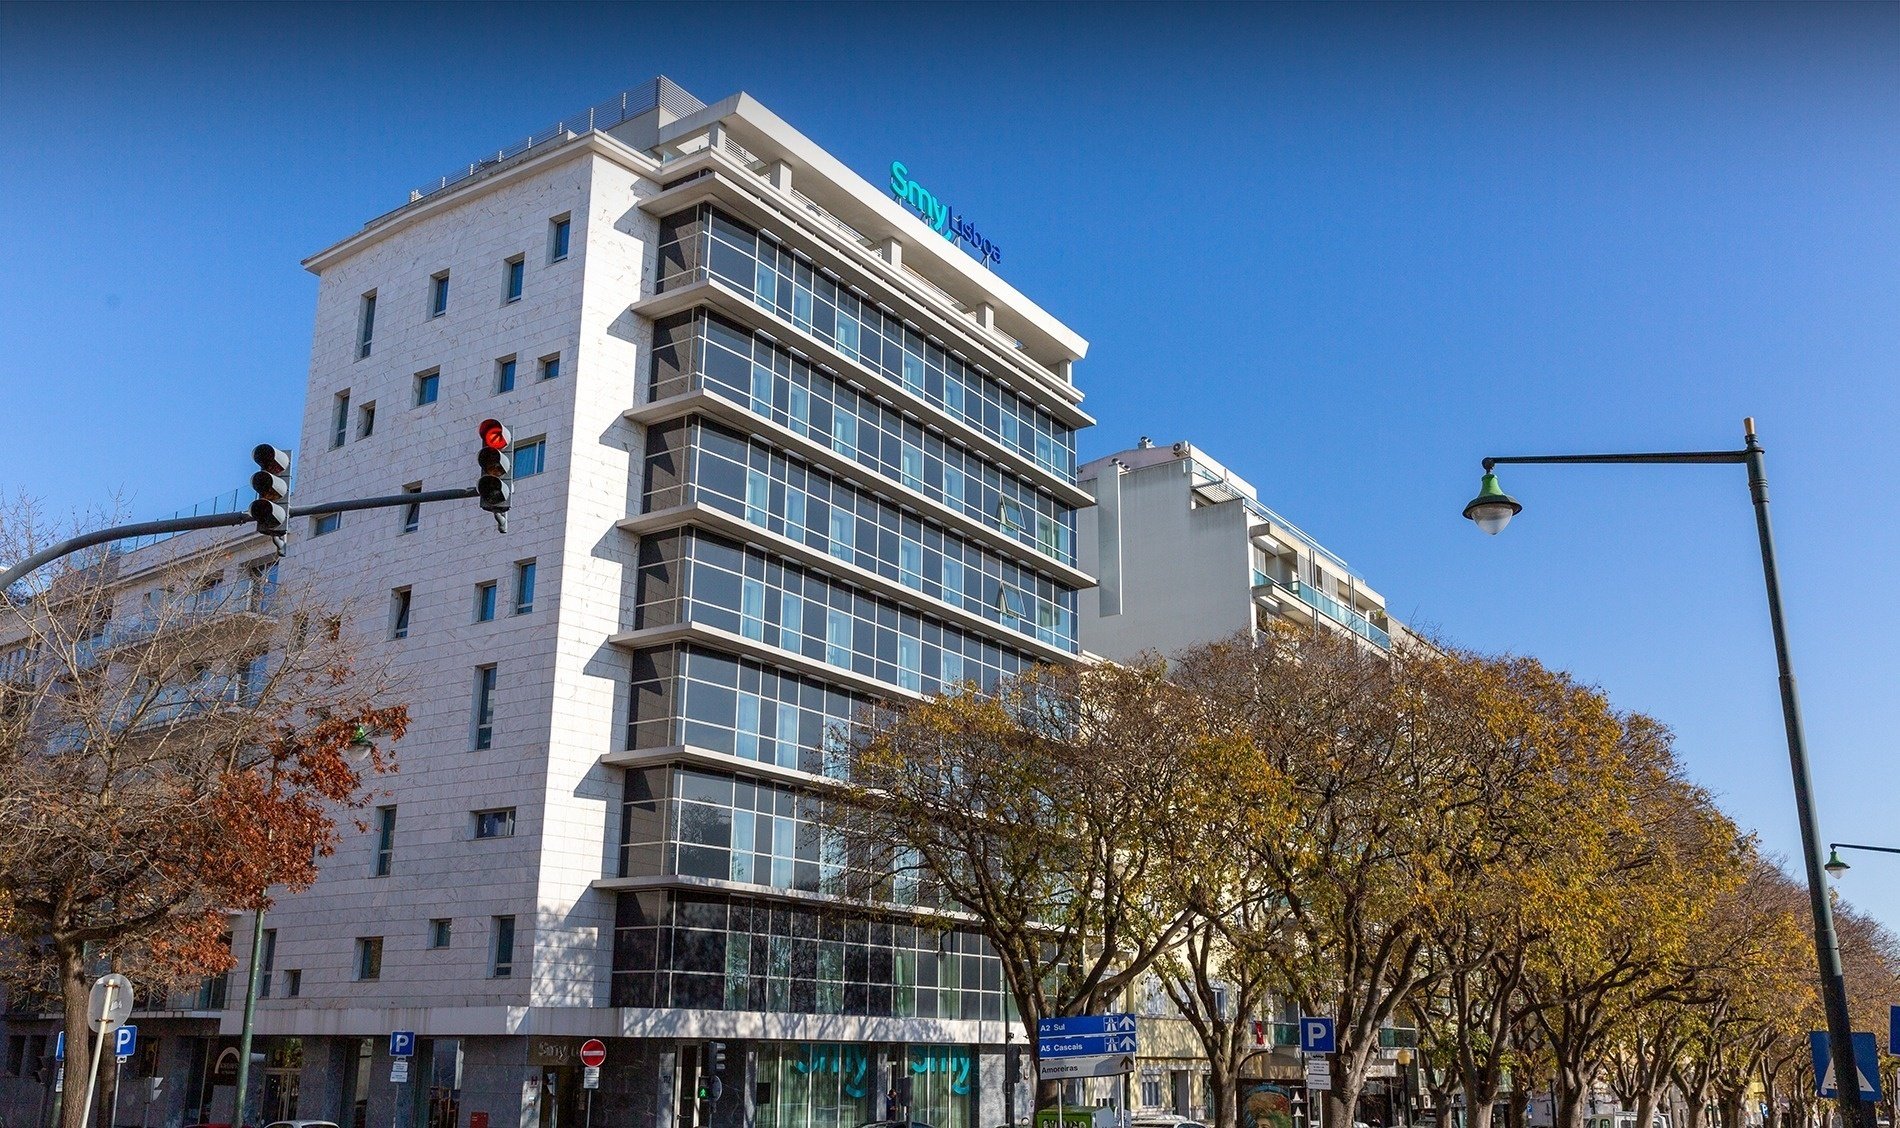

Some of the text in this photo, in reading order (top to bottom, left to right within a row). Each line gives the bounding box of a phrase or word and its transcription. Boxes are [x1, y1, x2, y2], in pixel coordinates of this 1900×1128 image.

[890, 160, 1002, 264] Smy Lisboa
[1040, 1023, 1066, 1032] A2 Sul
[1308, 1022, 1327, 1047] P
[116, 1029, 132, 1053] P
[396, 1034, 409, 1052] P
[1040, 1042, 1083, 1052] A5 Cascais
[1041, 1065, 1079, 1074] Amoreiras
